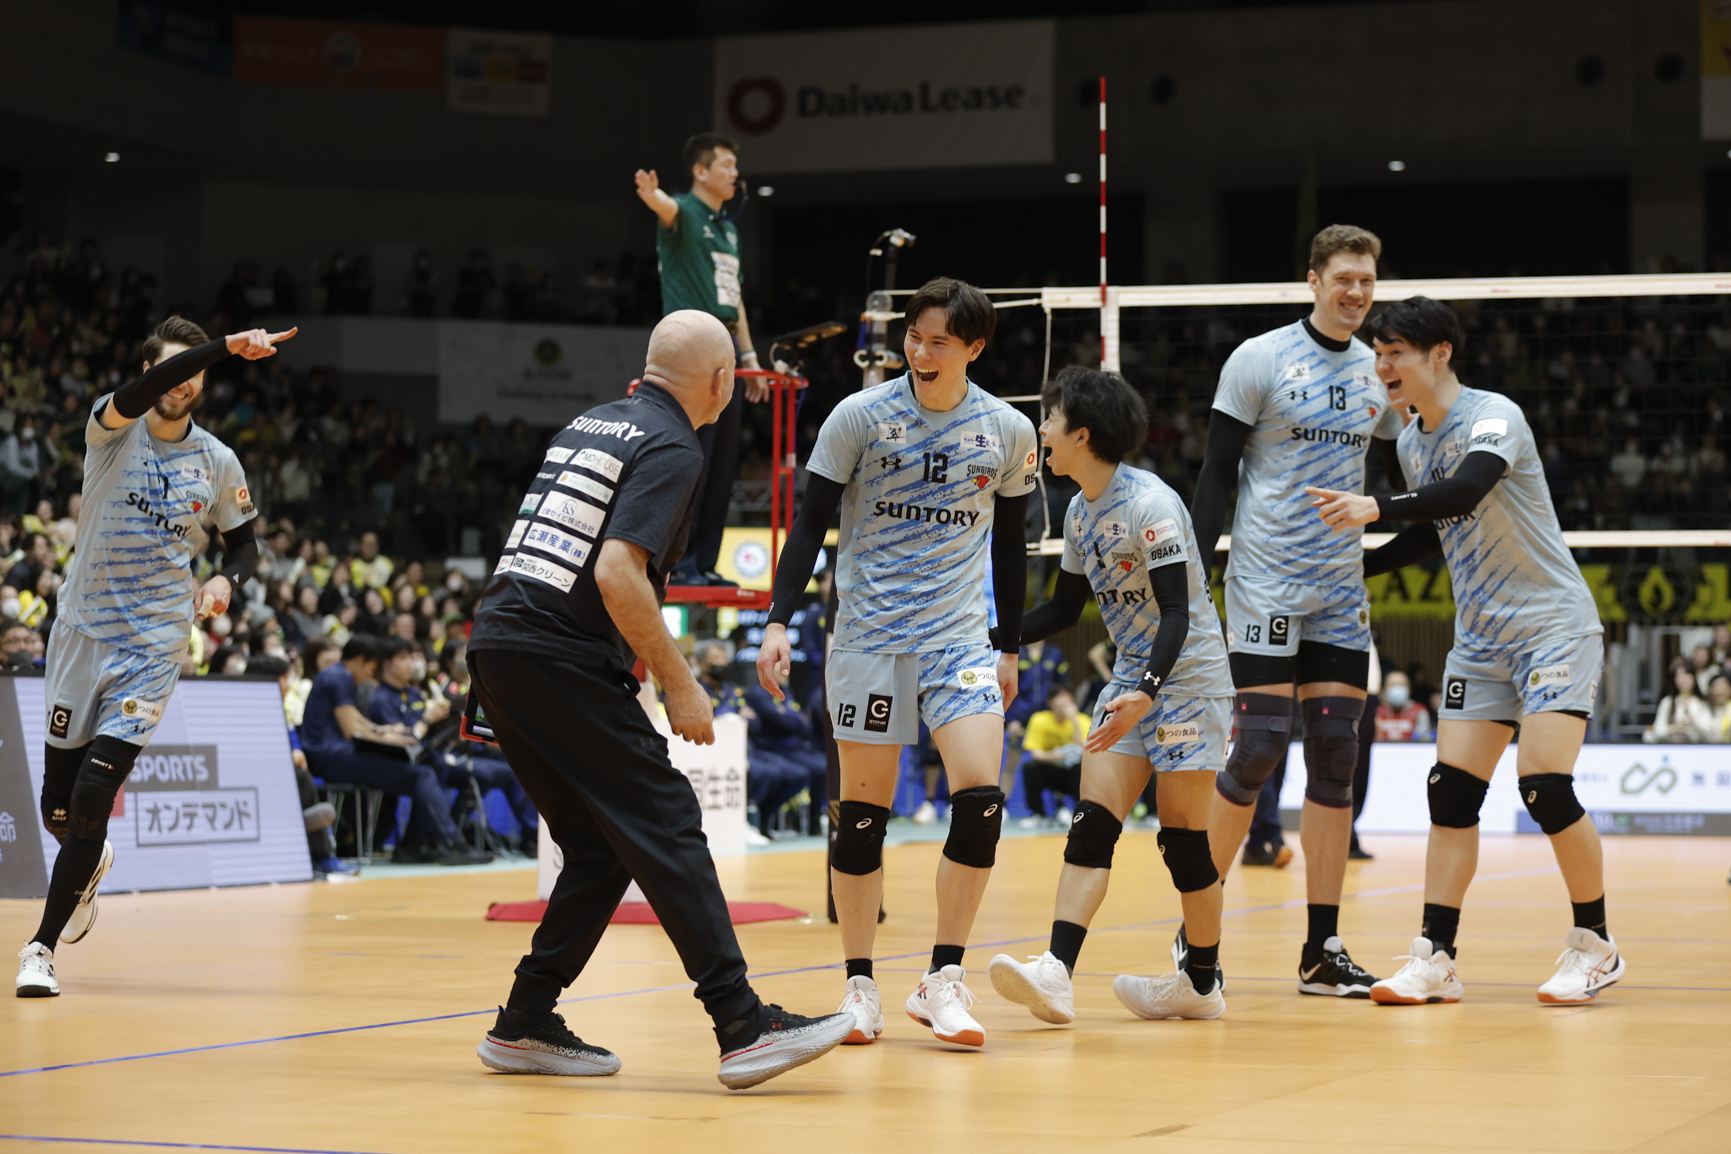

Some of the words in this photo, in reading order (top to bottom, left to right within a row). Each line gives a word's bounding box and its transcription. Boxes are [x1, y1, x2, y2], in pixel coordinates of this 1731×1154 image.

[1329, 385, 1346, 410] 13
[566, 415, 645, 442] SUNTORY
[923, 452, 949, 484] 12
[966, 464, 998, 480] SUNBIRDS
[873, 501, 980, 526] SUNTORY
[1151, 543, 1182, 561] OSAKA
[521, 562, 571, 588] 関西クリーン
[1245, 624, 1261, 643] 13
[1541, 669, 1569, 679] つの食品
[837, 702, 856, 728] 12
[1166, 727, 1197, 738] つの食品
[146, 799, 251, 833] オンデマンド
